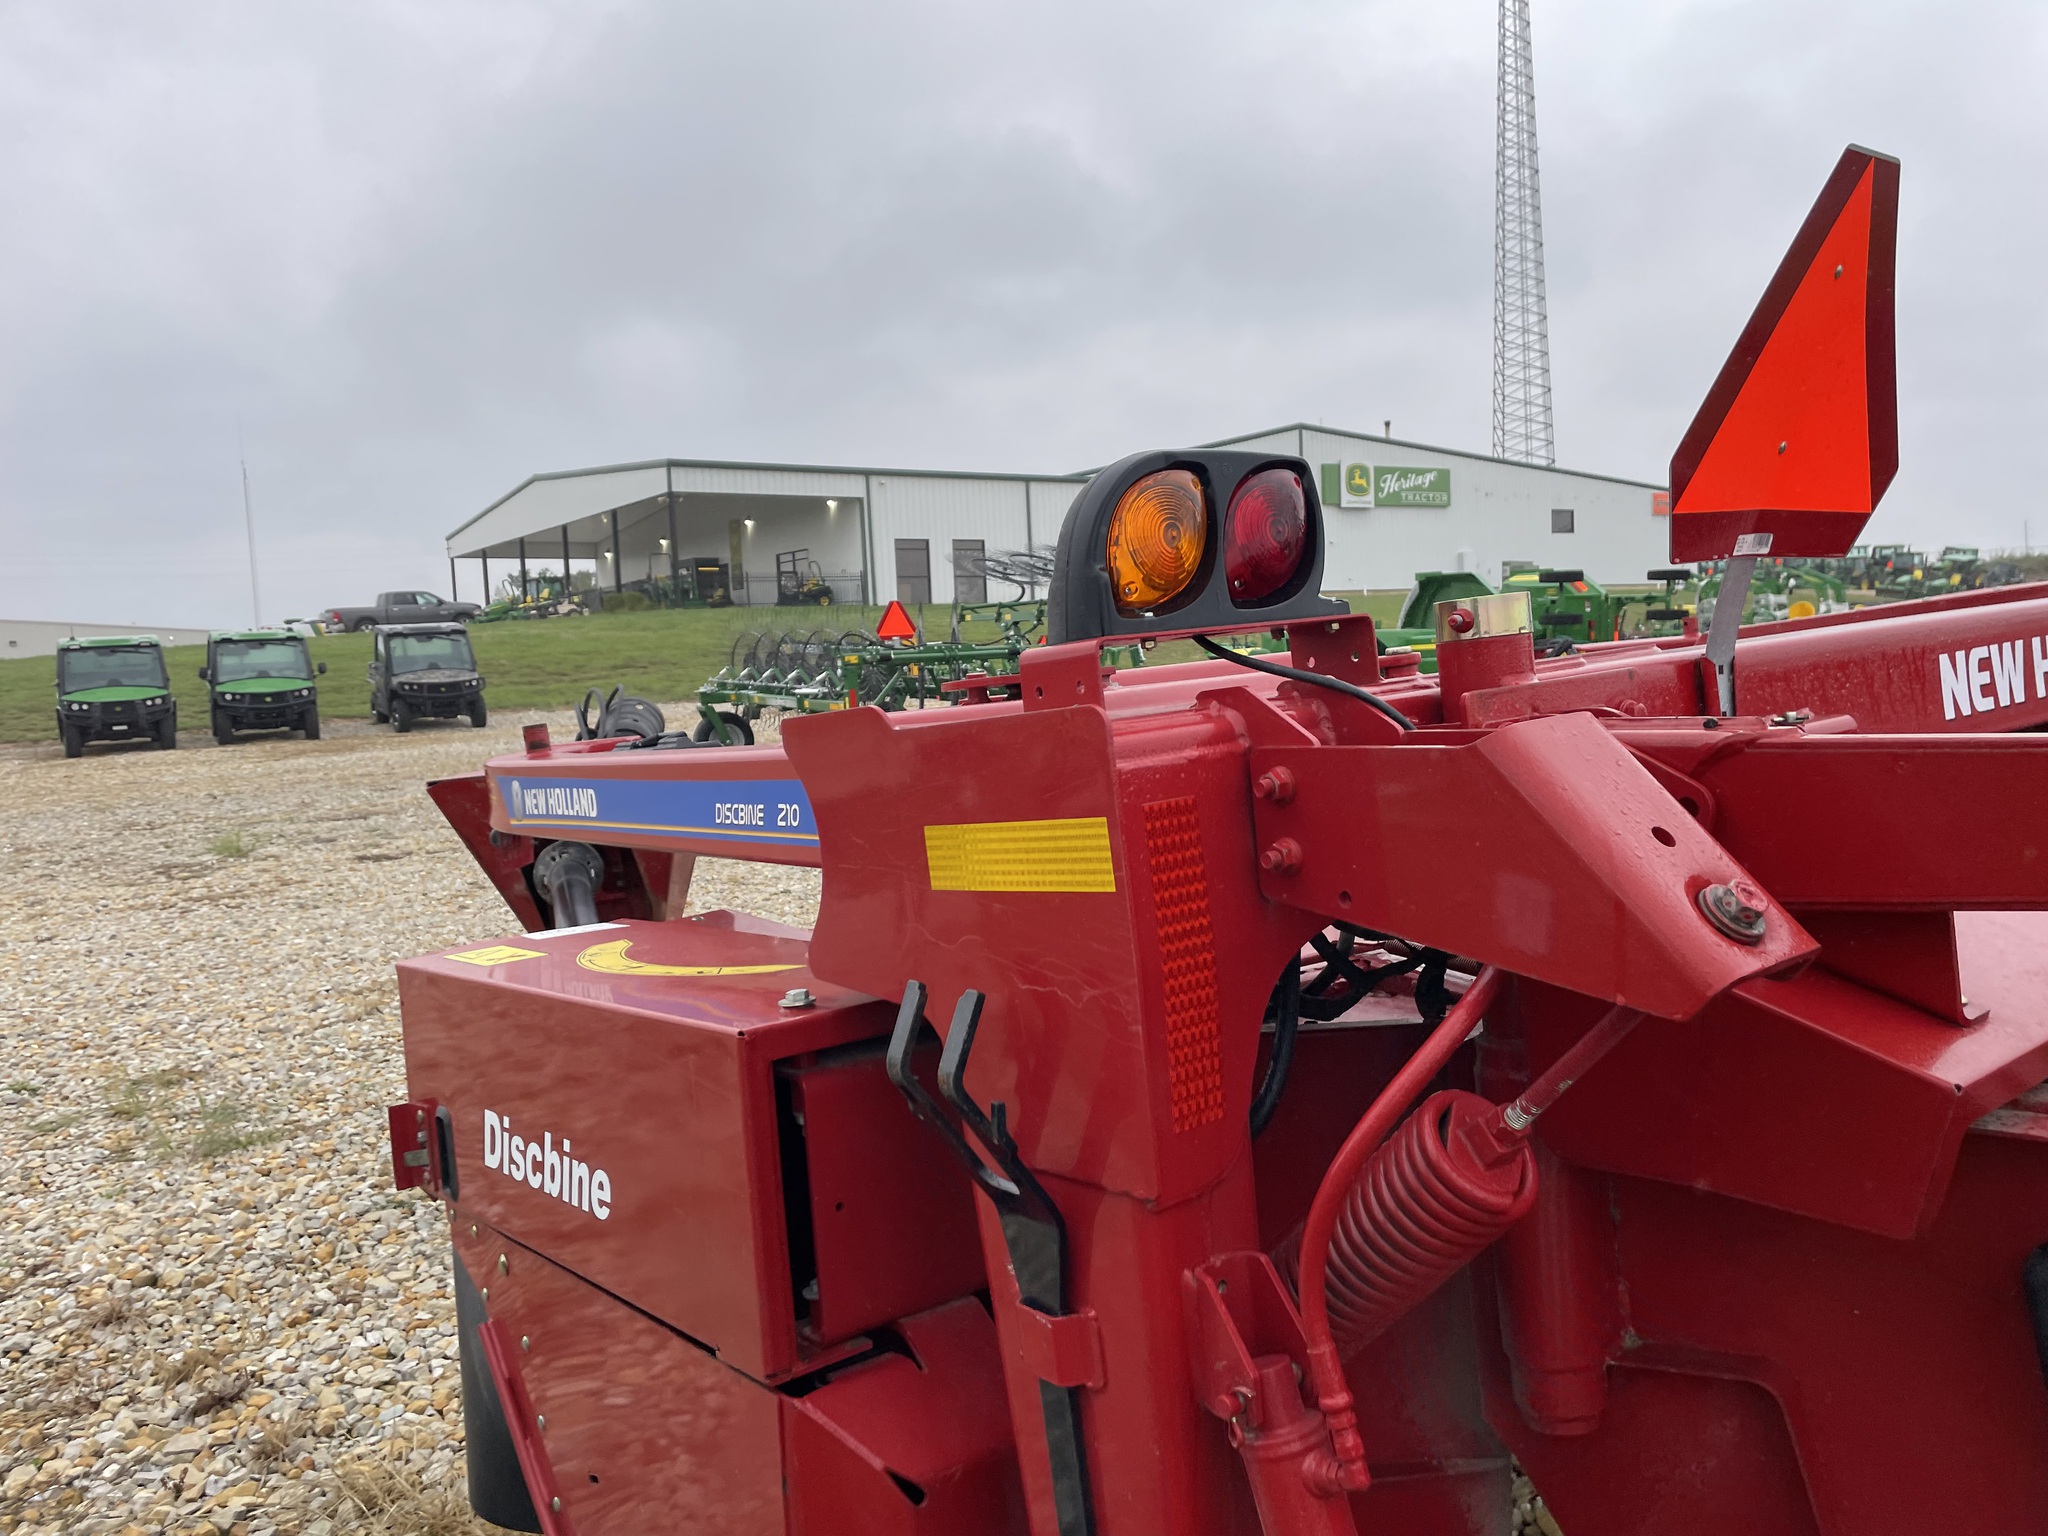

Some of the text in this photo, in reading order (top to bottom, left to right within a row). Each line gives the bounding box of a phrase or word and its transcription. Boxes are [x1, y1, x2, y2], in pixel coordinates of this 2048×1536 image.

[1379, 471, 1437, 498] Heritage
[1401, 492, 1448, 502] TRACTOR
[1939, 639, 2025, 720] NEW
[524, 788, 597, 817] NEW HOLLAND
[715, 803, 799, 827] DISCBINE 210
[484, 1108, 612, 1220] Discbine
